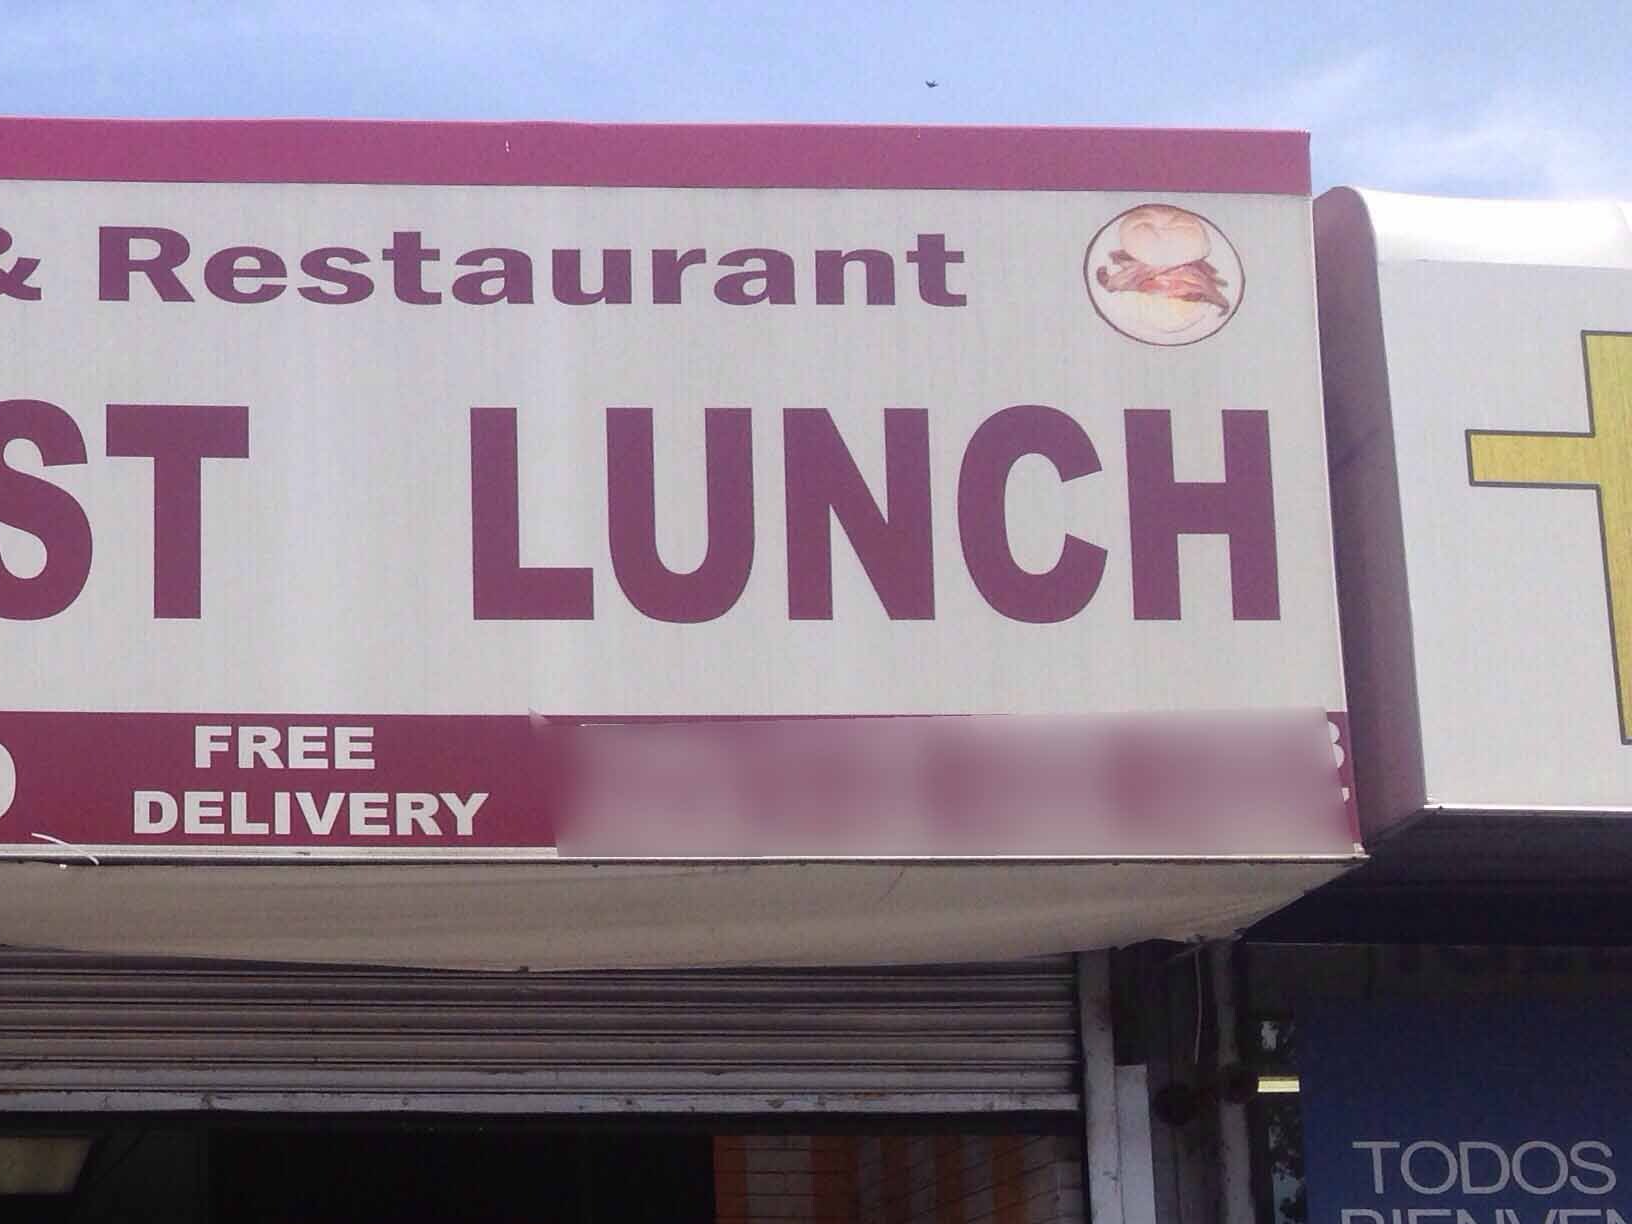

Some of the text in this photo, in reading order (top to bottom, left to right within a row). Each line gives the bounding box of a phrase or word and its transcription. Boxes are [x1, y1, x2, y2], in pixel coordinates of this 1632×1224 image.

[98, 225, 967, 307] Restaurant
[470, 404, 1280, 622] LUNCH
[194, 725, 375, 770] FREE
[133, 790, 489, 836] DELIVERY
[1351, 1139, 1618, 1195] TODOS
